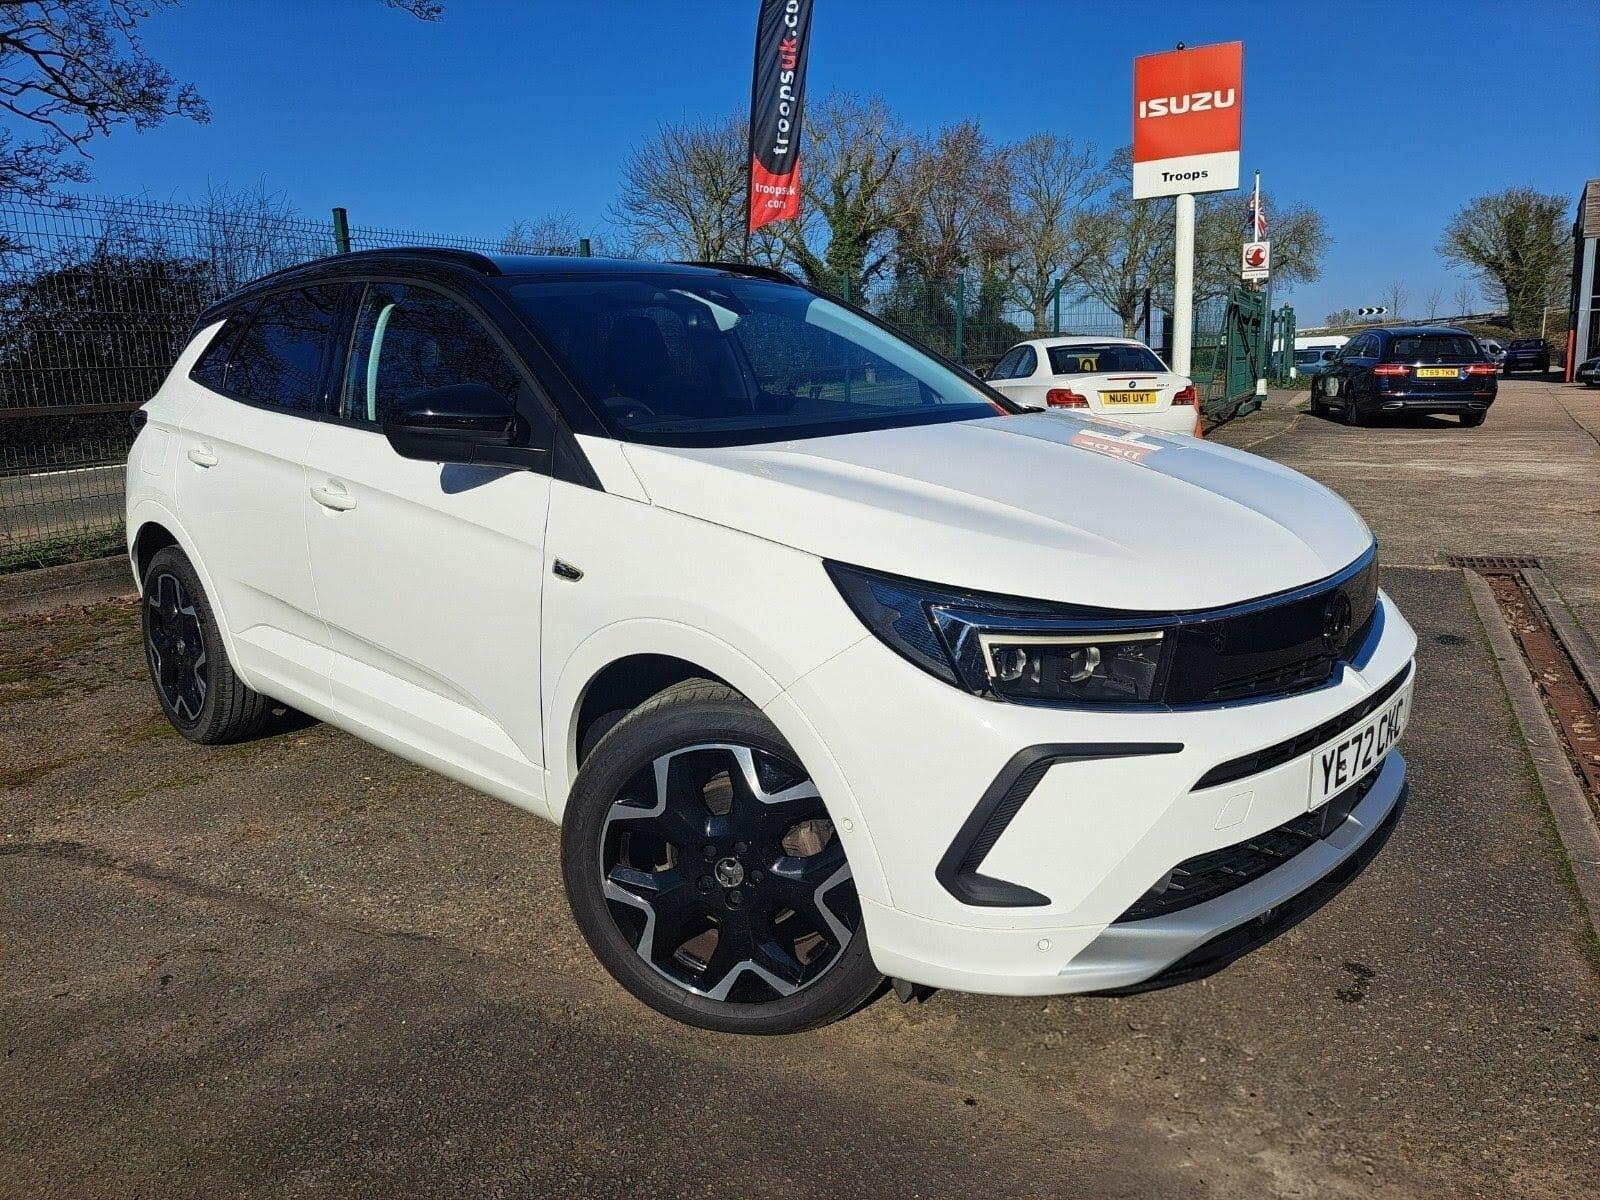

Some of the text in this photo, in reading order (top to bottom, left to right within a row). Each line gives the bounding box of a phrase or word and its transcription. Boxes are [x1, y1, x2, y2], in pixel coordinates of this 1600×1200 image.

[1139, 88, 1235, 119] ISUZU
[1162, 170, 1208, 182] Troops
[755, 183, 796, 197] troopsk
[1109, 393, 1150, 403] NU61 UVT
[1322, 698, 1404, 795] YE72 CKC
